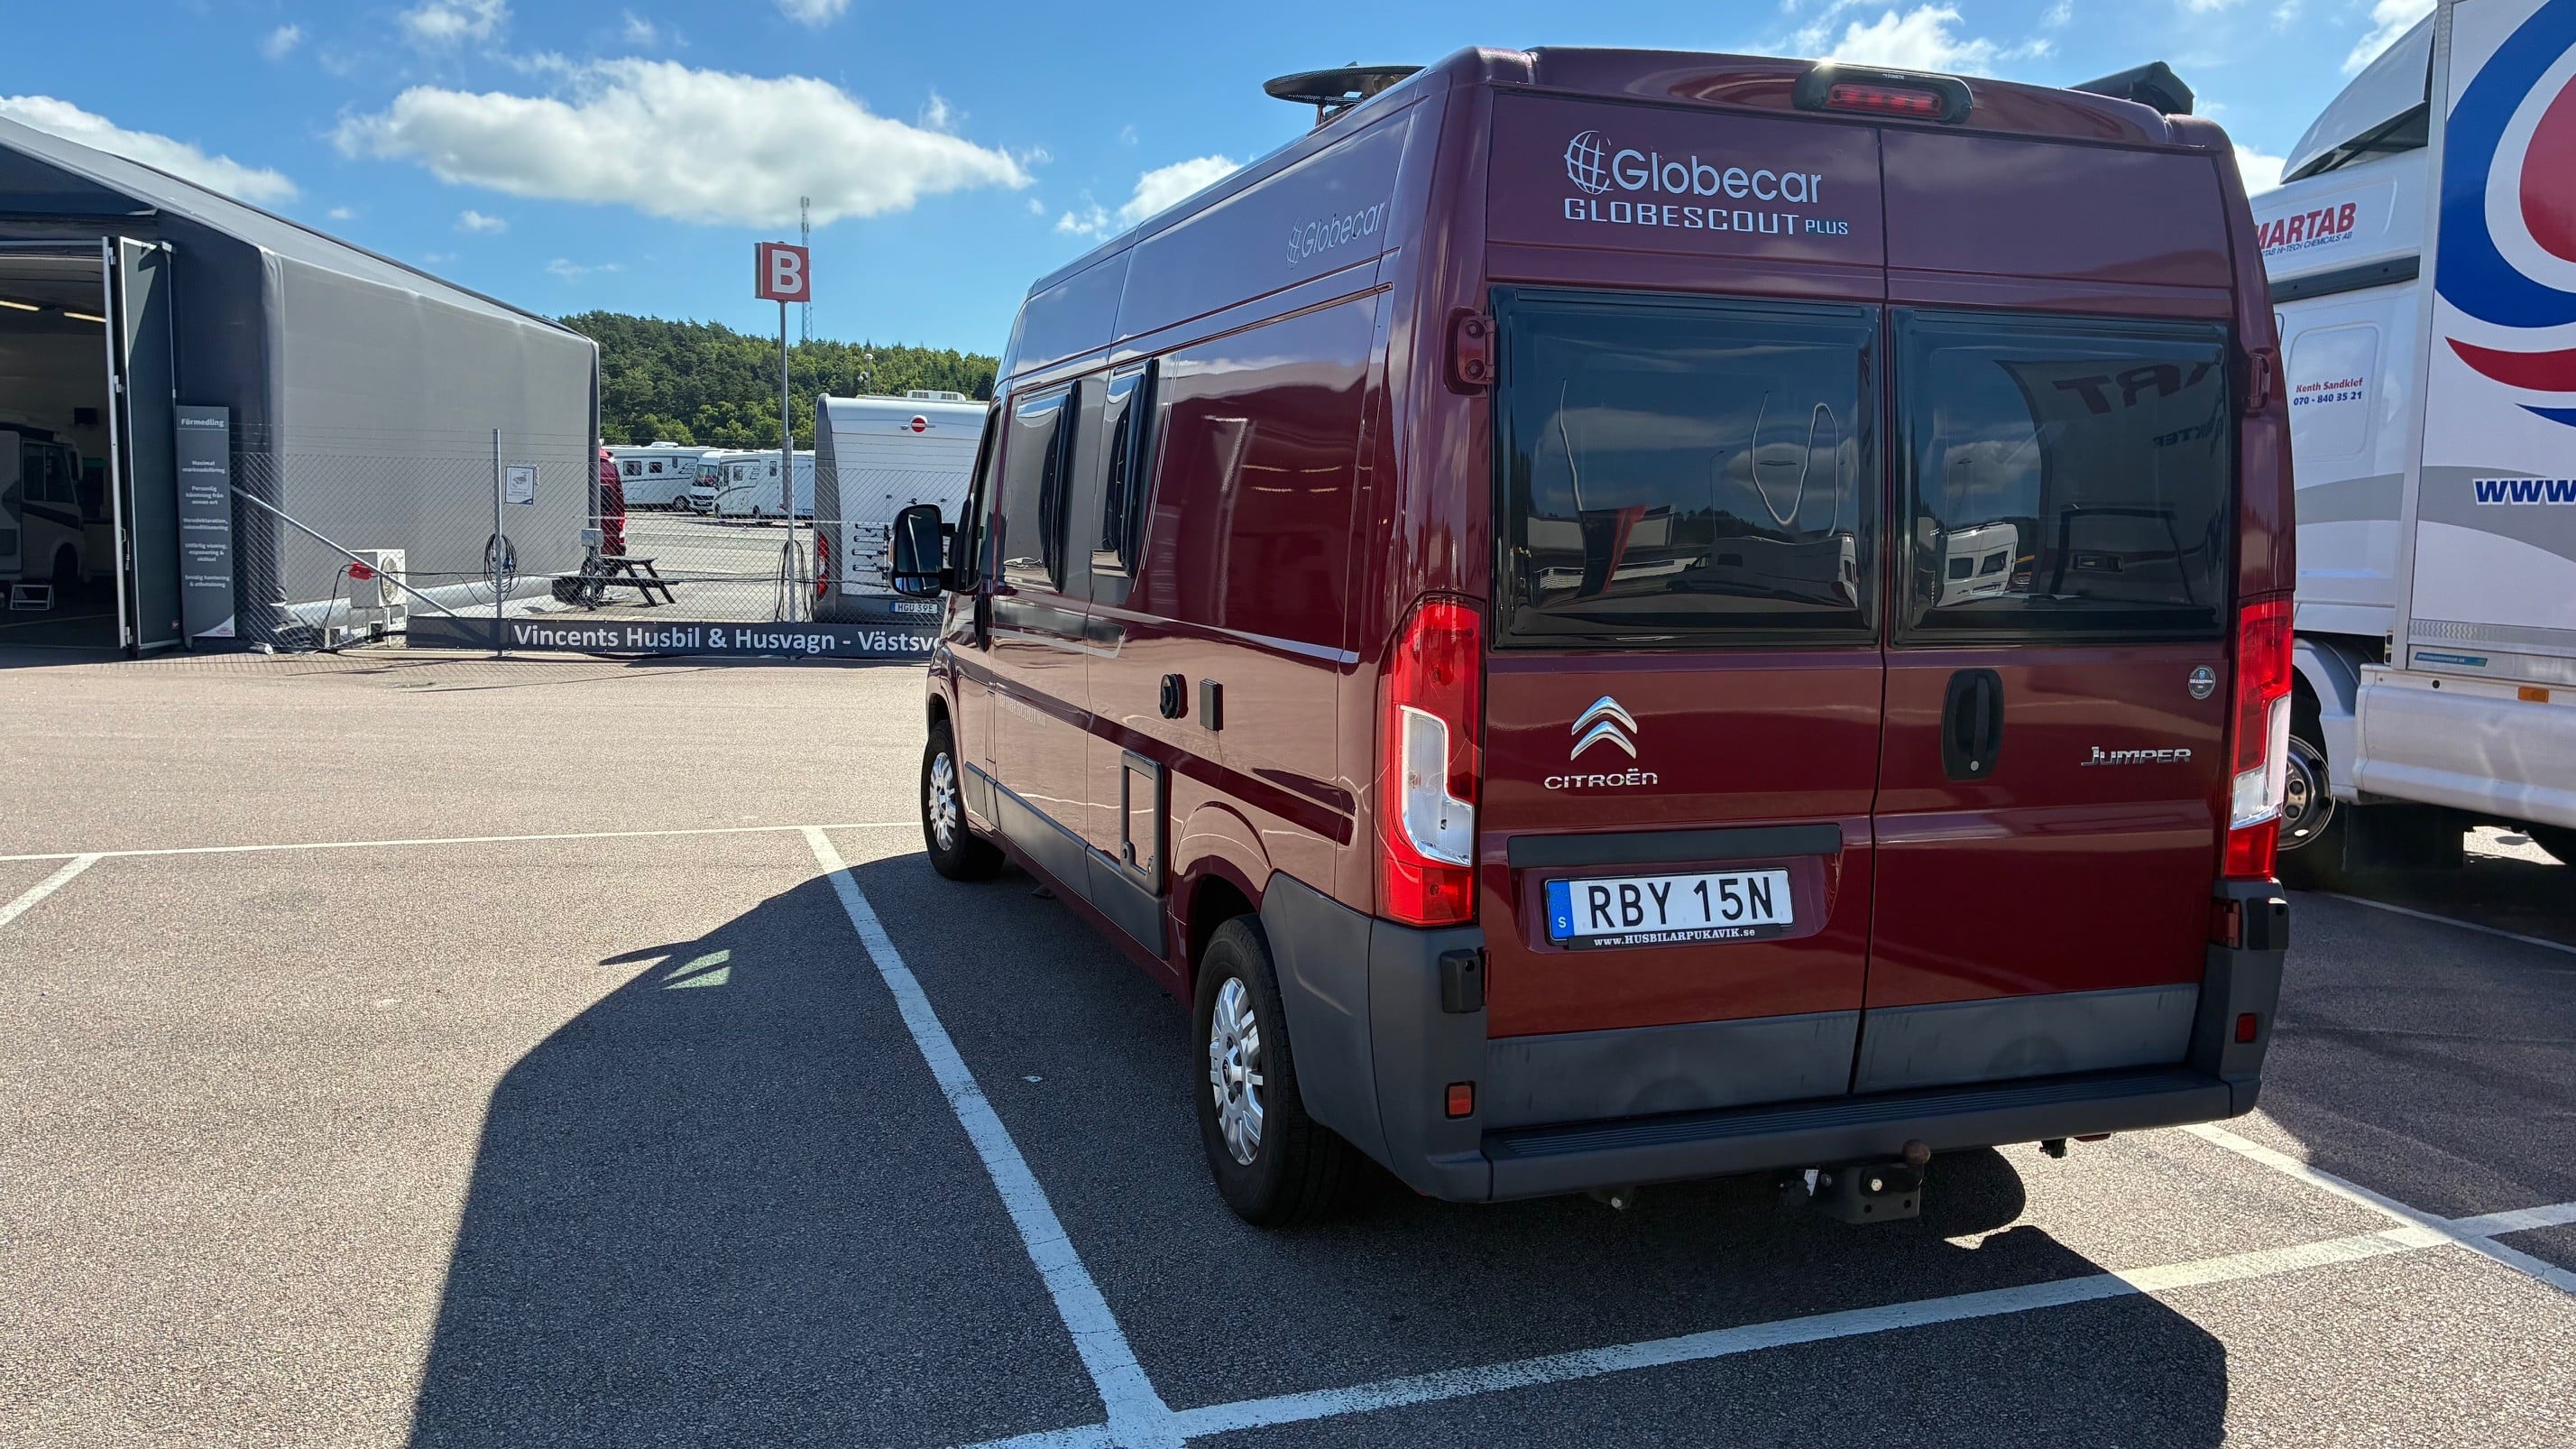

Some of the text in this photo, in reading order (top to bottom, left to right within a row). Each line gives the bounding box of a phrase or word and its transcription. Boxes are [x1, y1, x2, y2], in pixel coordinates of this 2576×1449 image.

[1612, 149, 1822, 204] Globecar
[1565, 198, 1848, 235] GLOBESCOUT PLUS
[1302, 201, 1385, 258] Globecar
[2304, 234, 2341, 248] CHEMICALS
[771, 249, 803, 294] B
[2294, 397, 2310, 406] 070
[2317, 394, 2334, 403] 840
[2337, 392, 2348, 401] 35
[2351, 391, 2362, 400] 21
[2295, 383, 2322, 393] Kenth
[181, 418, 225, 428] Förmedling
[513, 624, 619, 648] Vincents
[626, 627, 700, 649] Husbil
[707, 628, 727, 649] &
[735, 629, 835, 653] Husvagn
[1544, 768, 1658, 789] CITROËN
[1587, 877, 1773, 929] RBY 15N
[1558, 917, 1567, 928] S
[1594, 928, 1756, 946] www.HUSBILARPUKAVIK.se
